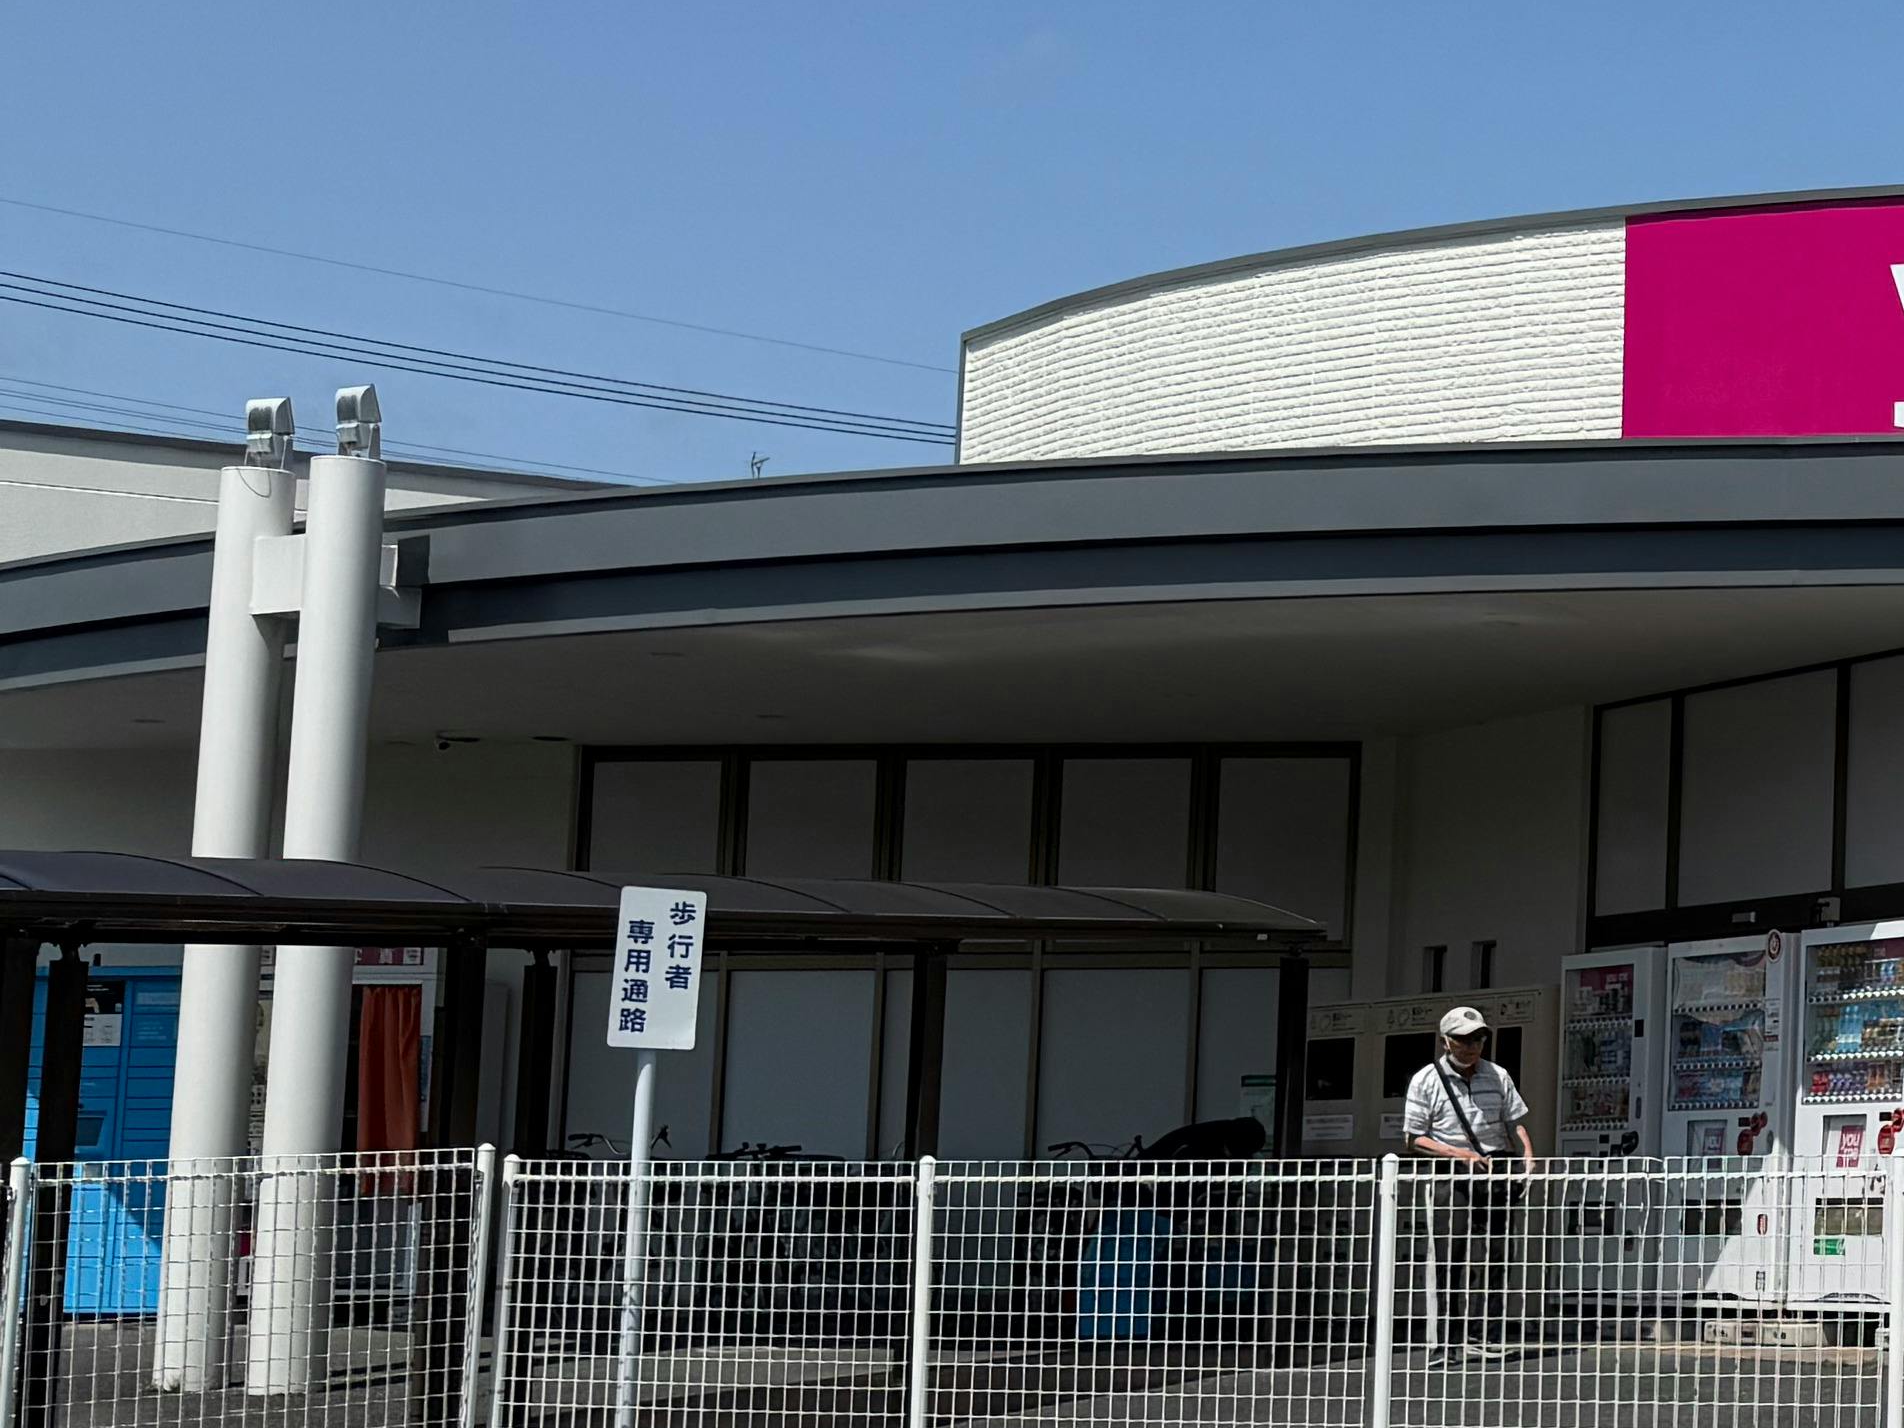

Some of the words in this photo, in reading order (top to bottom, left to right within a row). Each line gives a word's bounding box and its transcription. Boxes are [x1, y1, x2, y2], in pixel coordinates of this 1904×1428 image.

[619, 920, 655, 1033] 専用通路
[665, 901, 696, 990] 歩行者
